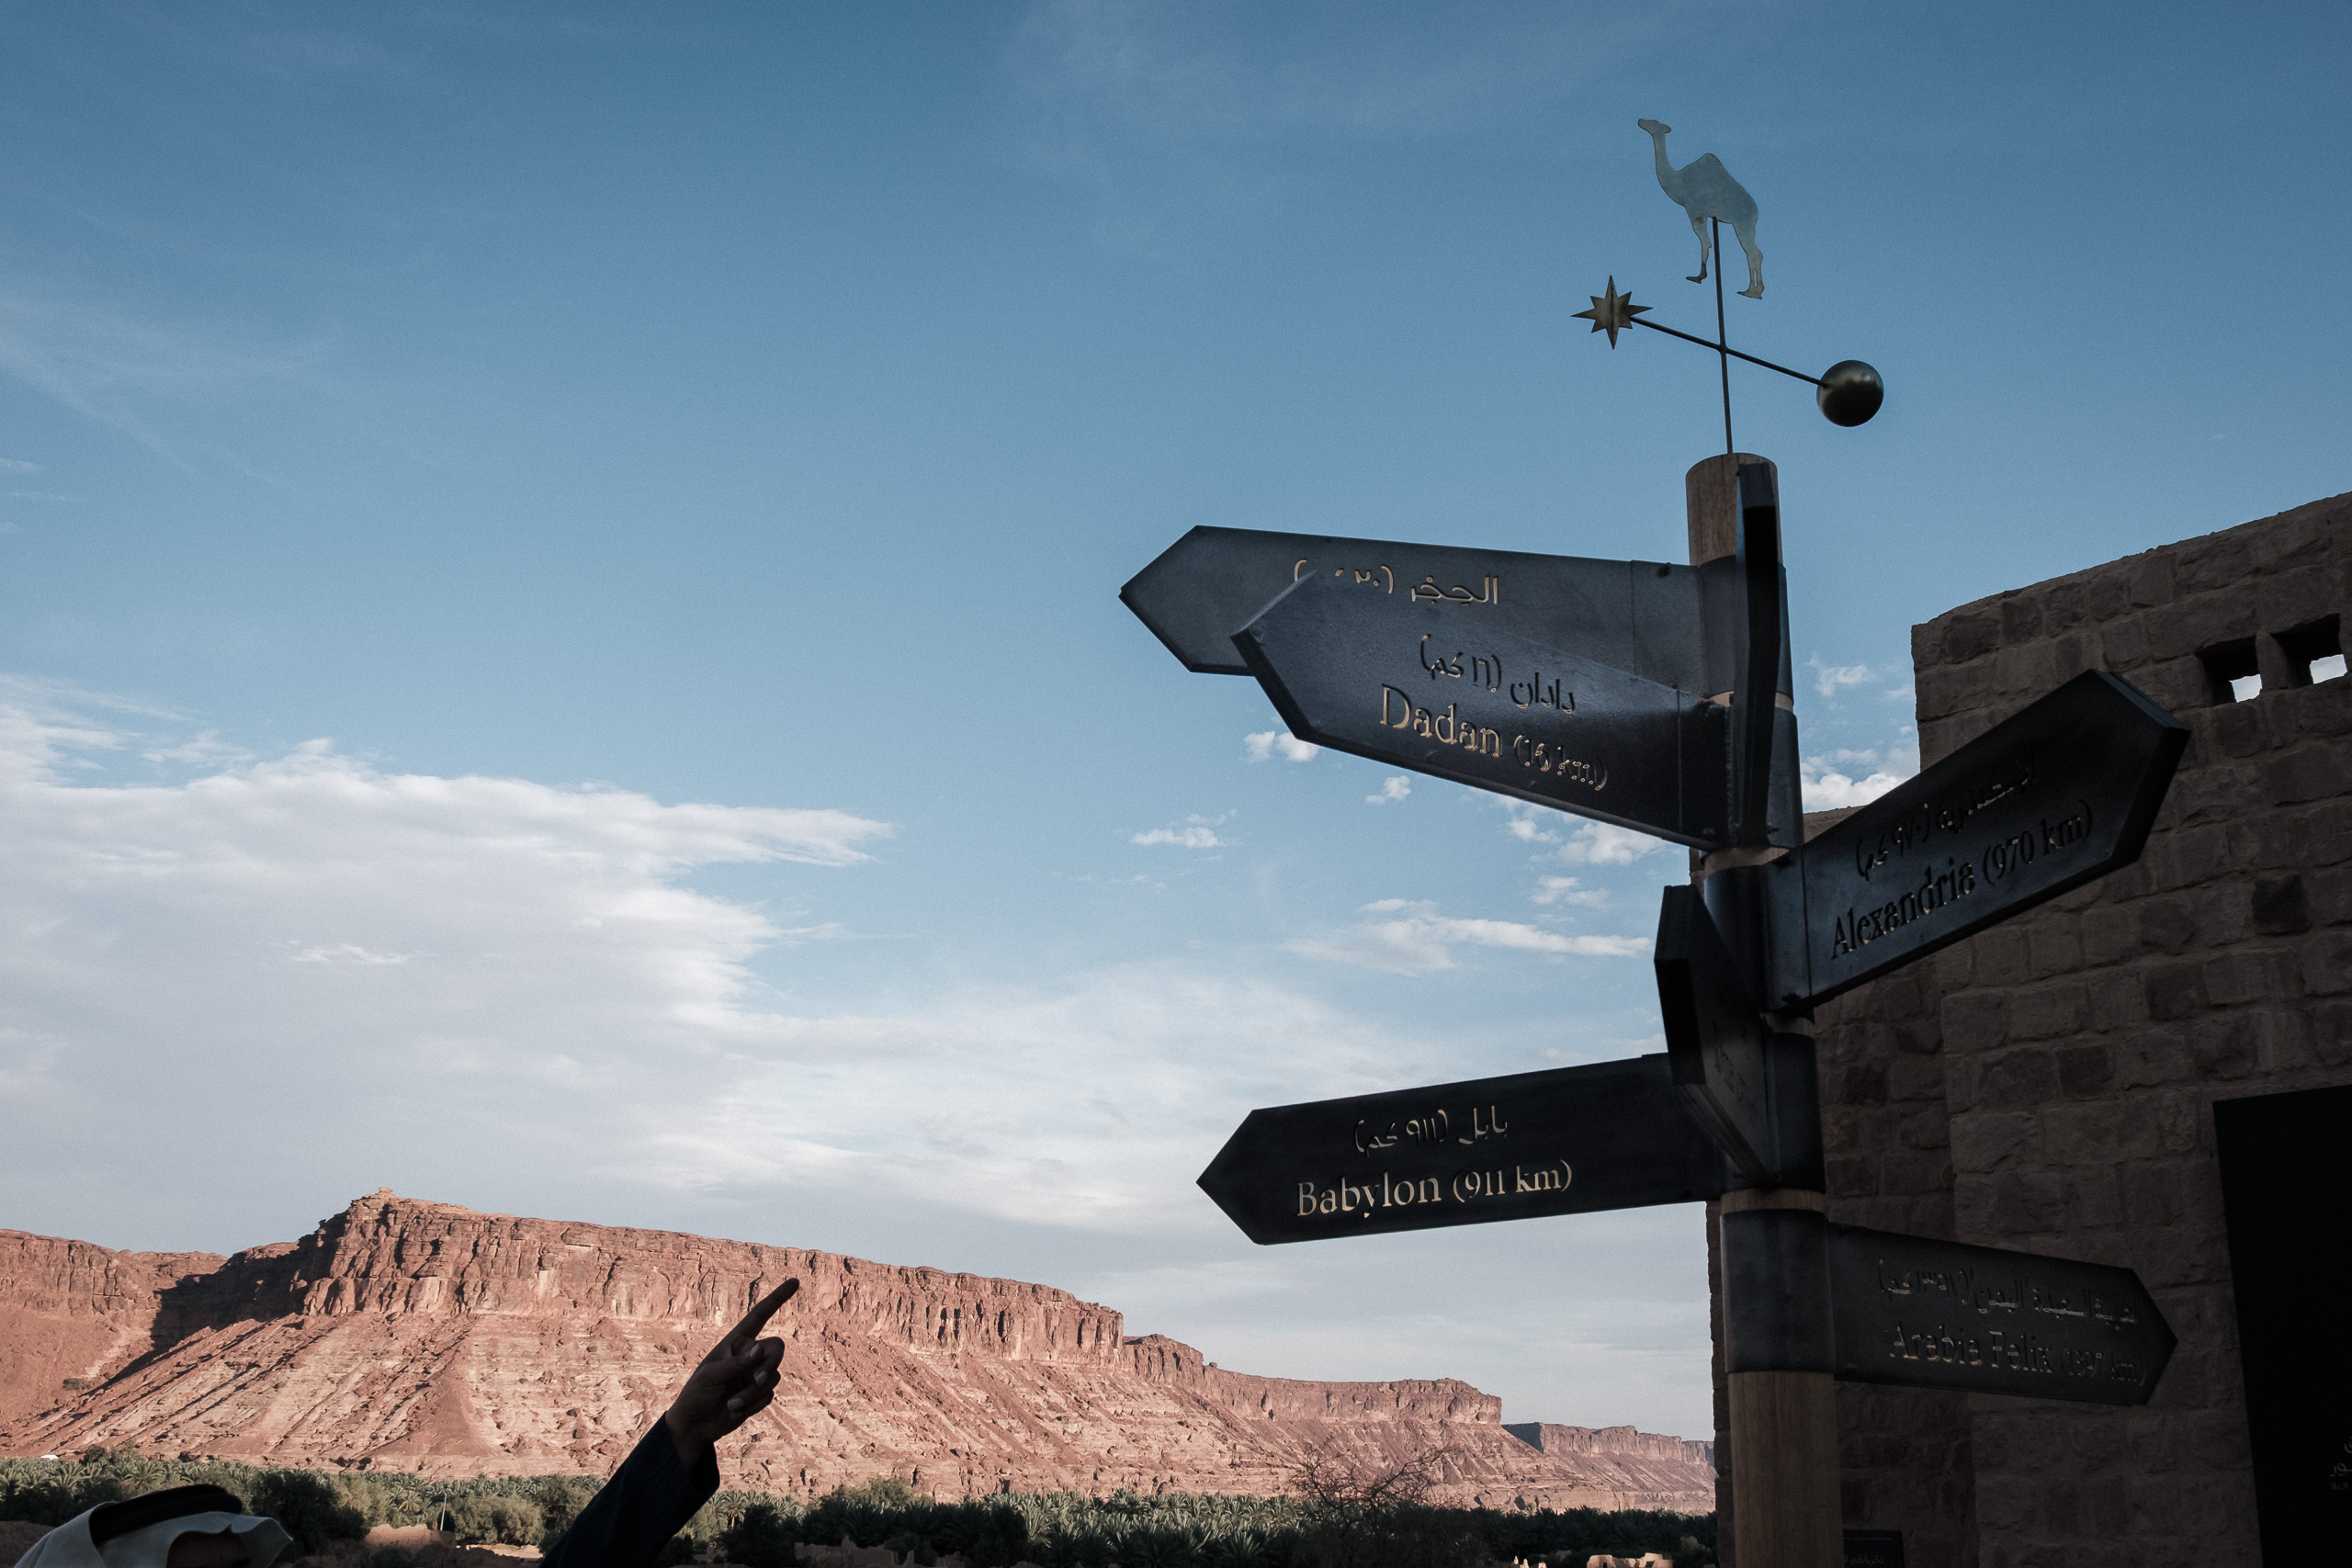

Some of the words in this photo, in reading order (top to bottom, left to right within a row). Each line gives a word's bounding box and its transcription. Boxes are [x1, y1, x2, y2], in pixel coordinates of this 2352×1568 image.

[1510, 672, 1575, 714] دادان
[1379, 684, 1502, 758] Dadan
[1513, 734, 1553, 772] (16
[1556, 745, 1609, 791] km)
[1831, 857, 1976, 960] Alexandria
[1984, 830, 2035, 886] (970
[2040, 799, 2092, 855] km)
[1458, 1105, 1508, 1145] بابل
[1296, 1169, 1442, 1218] Babylon
[1453, 1168, 1506, 1203] (911
[1514, 1158, 1573, 1193] km)
[1890, 1322, 1983, 1366] Arabia
[1989, 1331, 2053, 1374] Felix
